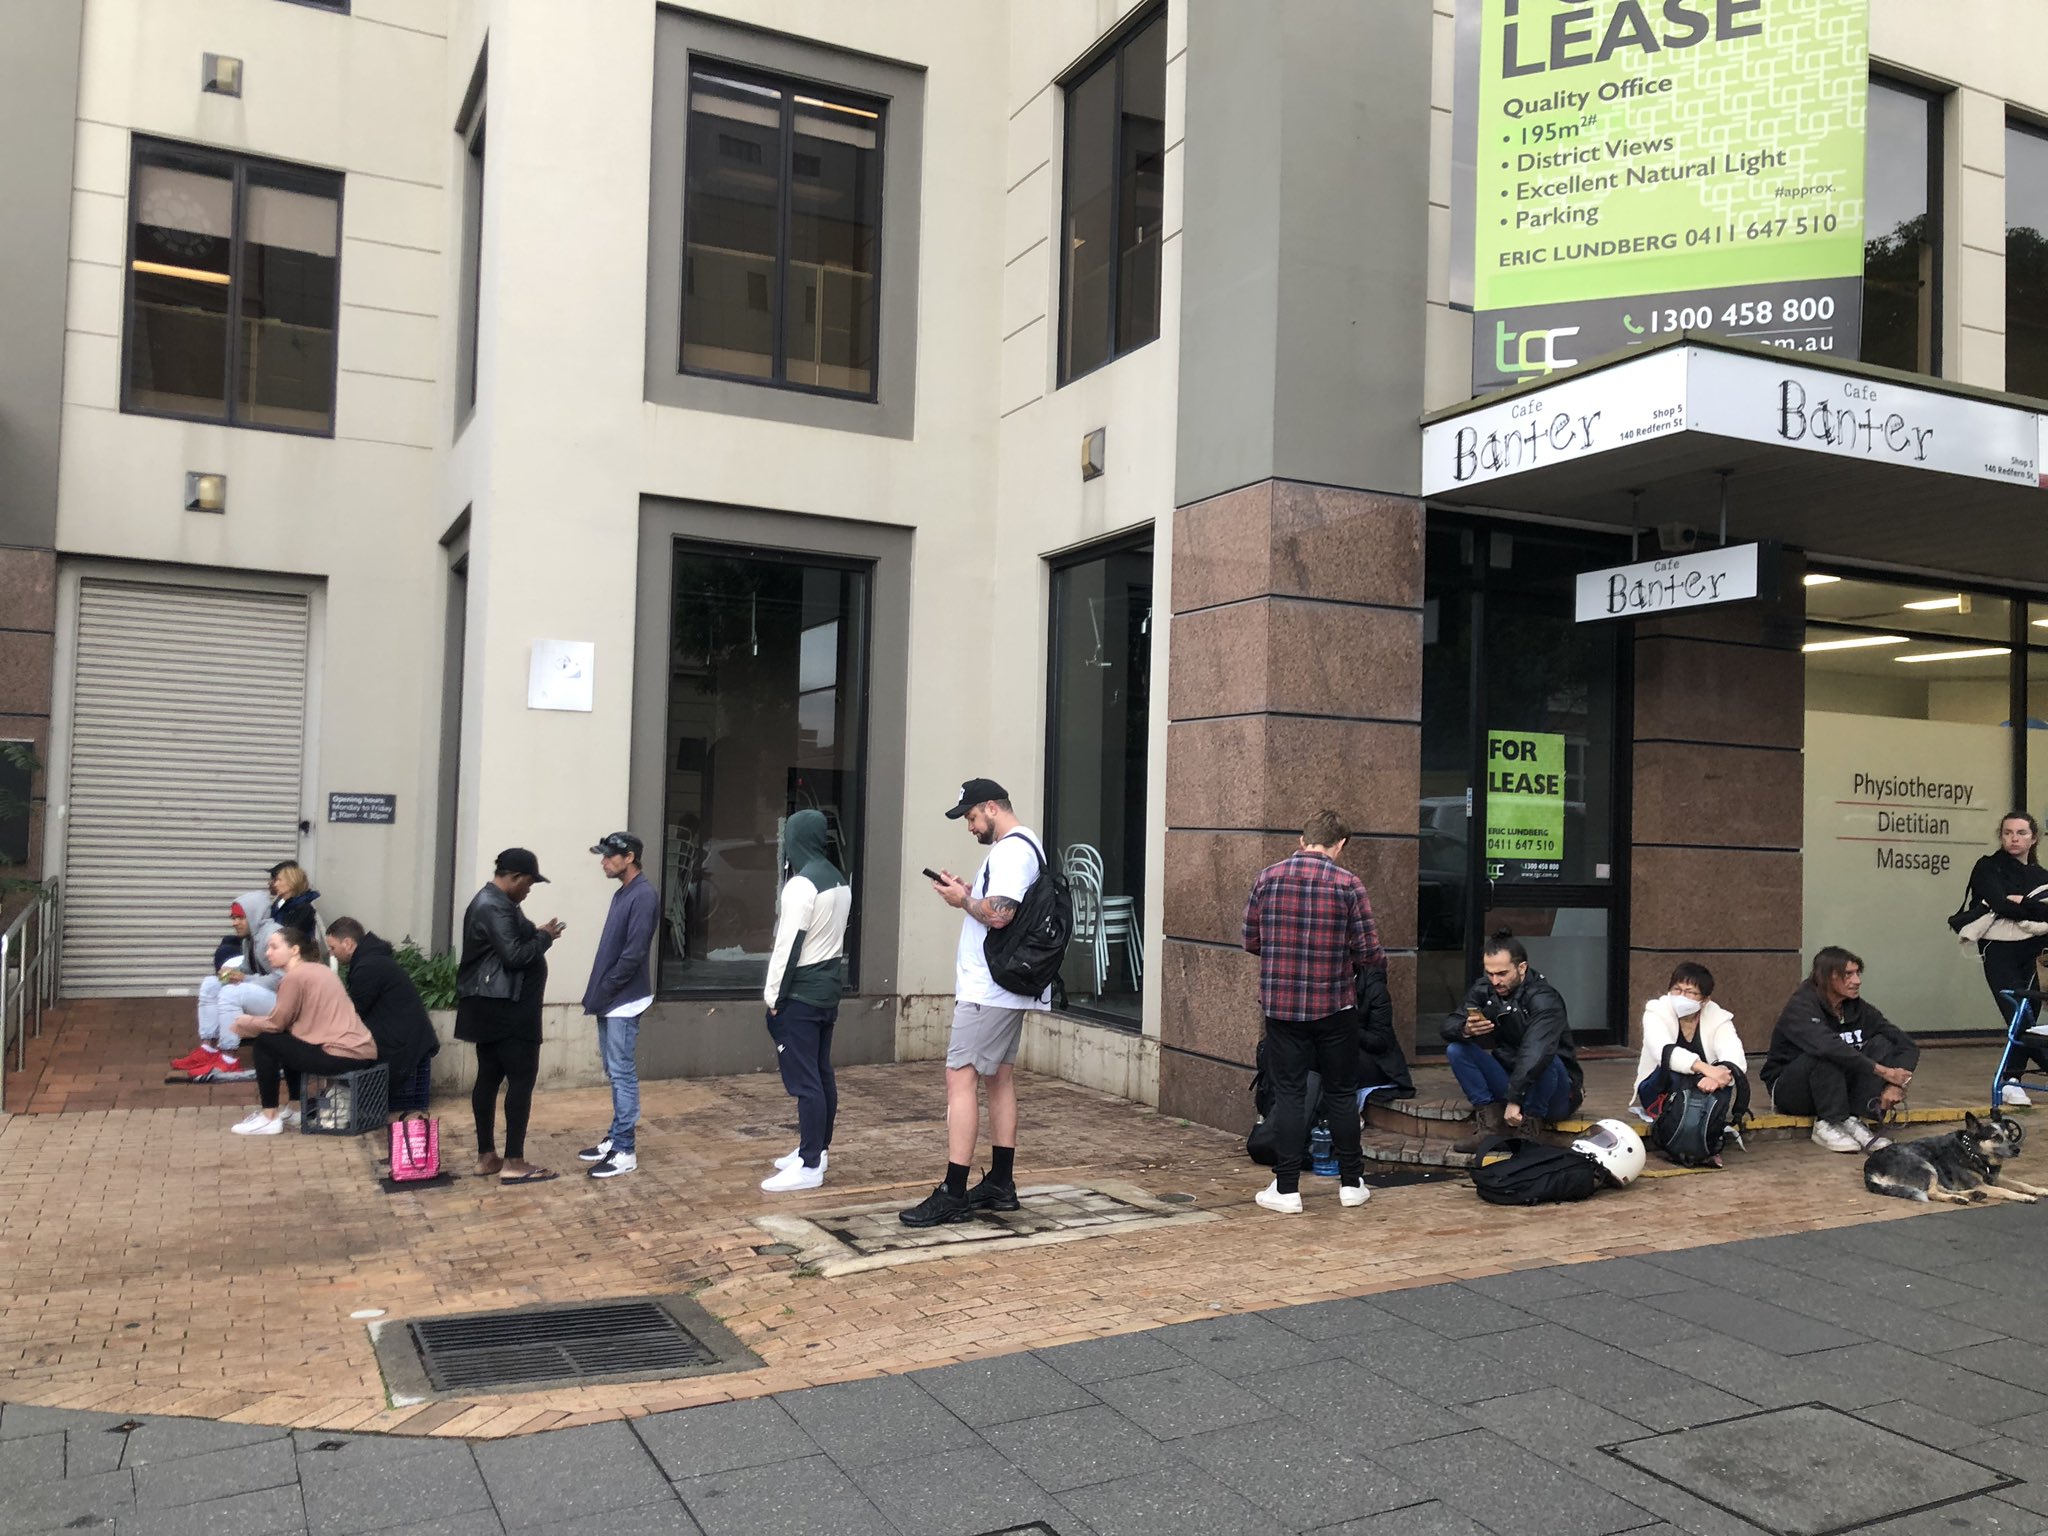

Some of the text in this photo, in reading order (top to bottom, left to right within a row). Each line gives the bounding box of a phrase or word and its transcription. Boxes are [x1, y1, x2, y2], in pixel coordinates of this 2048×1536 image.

[1502, 0, 1762, 79] LEASE
[1503, 77, 1673, 119] Quality Office
[1517, 137, 1673, 172] District Views
[1516, 149, 1787, 201] Excellent Natural Light
[1775, 183, 1836, 199] #approx.
[1516, 206, 1599, 229] Parking
[1499, 214, 1837, 267] ERIC LUNDBERG 0411 647 510
[1651, 296, 1836, 333] 1300 458 800
[1844, 382, 1877, 402] Cafe
[1511, 400, 1543, 419] Cafe
[1653, 404, 1683, 419] Shop 5
[1777, 379, 1933, 461] Banter
[1620, 418, 1683, 441] 140 Redfern St
[1453, 411, 1601, 481] Banter
[1985, 464, 1996, 473] 140
[1998, 466, 2025, 478] Redfern
[2011, 456, 2028, 469] Shop
[1654, 559, 1680, 572] Cafe
[1606, 570, 1726, 614] Banter
[1489, 739, 1537, 761] FOR
[1489, 771, 1559, 795] LEASE
[1854, 773, 1973, 805] Physiotherapy
[371, 805, 392, 813] Friday
[1507, 828, 1549, 836] LUNDBERG
[1878, 811, 1949, 835] Dietitian
[1488, 839, 1554, 851] 0411 647 510
[1877, 848, 1950, 875] Massage
